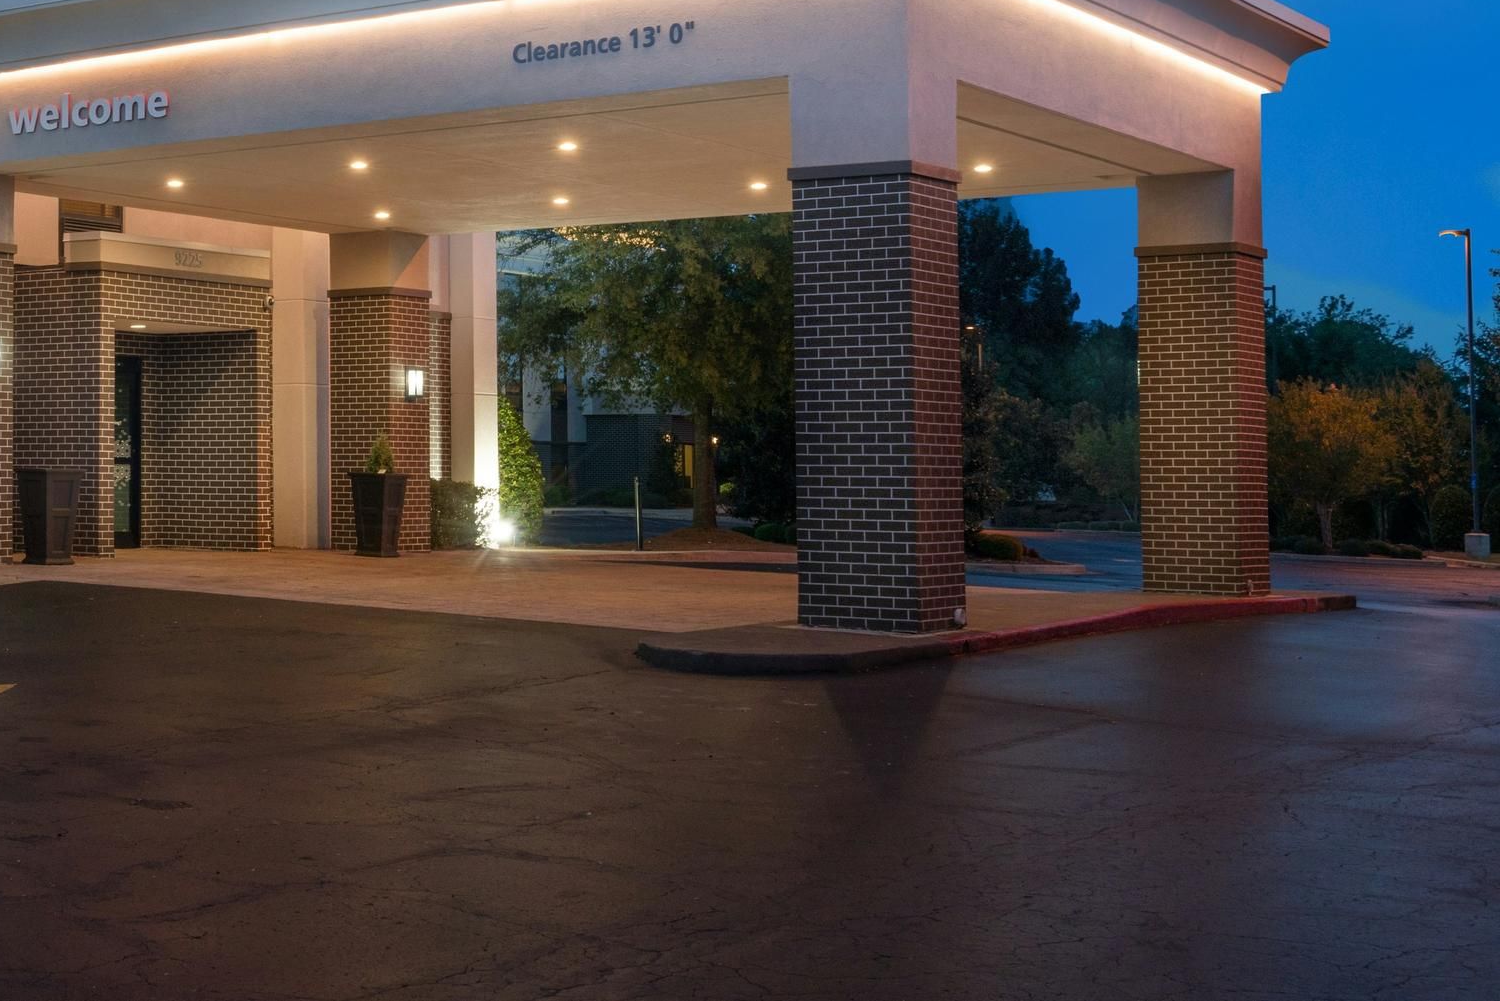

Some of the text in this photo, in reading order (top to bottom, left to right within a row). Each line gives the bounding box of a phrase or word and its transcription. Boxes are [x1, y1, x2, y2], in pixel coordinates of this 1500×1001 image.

[512, 35, 621, 64] Clearance
[629, 25, 661, 49] 13'
[8, 91, 169, 135] welcome
